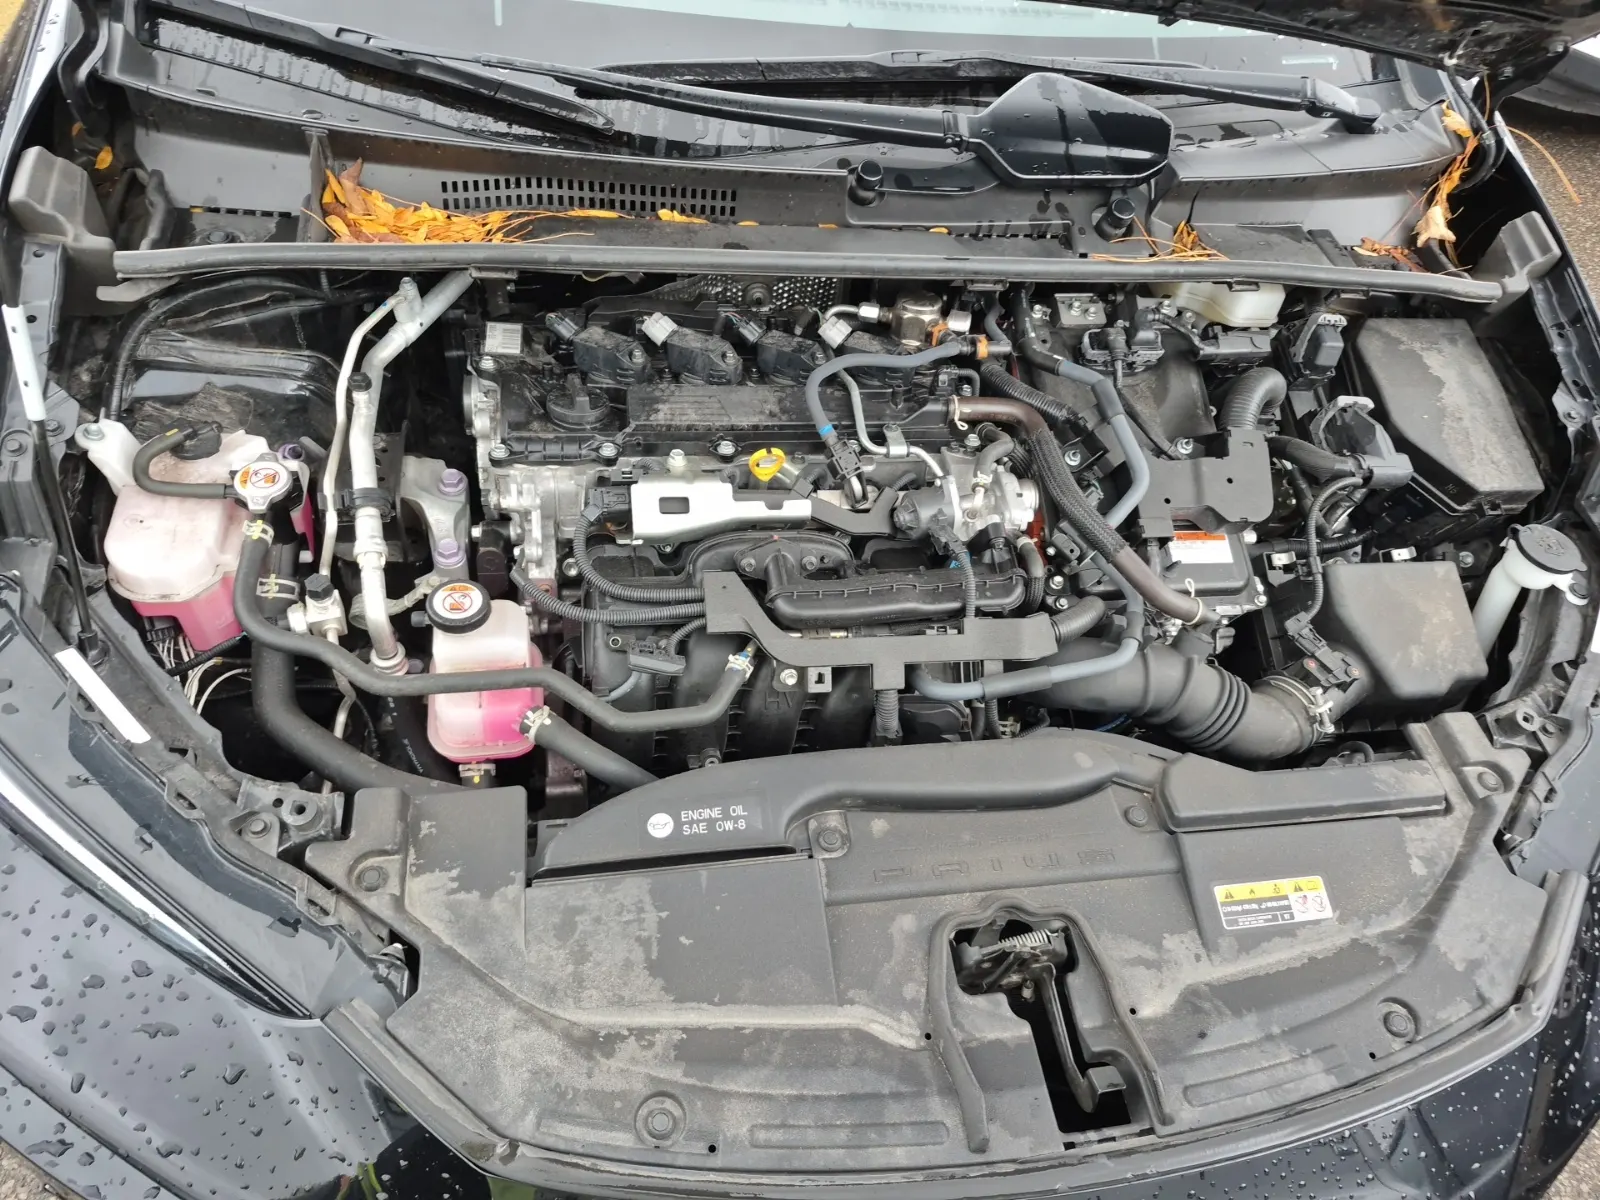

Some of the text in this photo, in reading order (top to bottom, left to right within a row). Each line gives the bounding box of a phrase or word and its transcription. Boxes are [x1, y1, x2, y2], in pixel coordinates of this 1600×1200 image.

[681, 805, 748, 821] ENGINE OIL
[683, 819, 746, 835] SAE 0W-8
